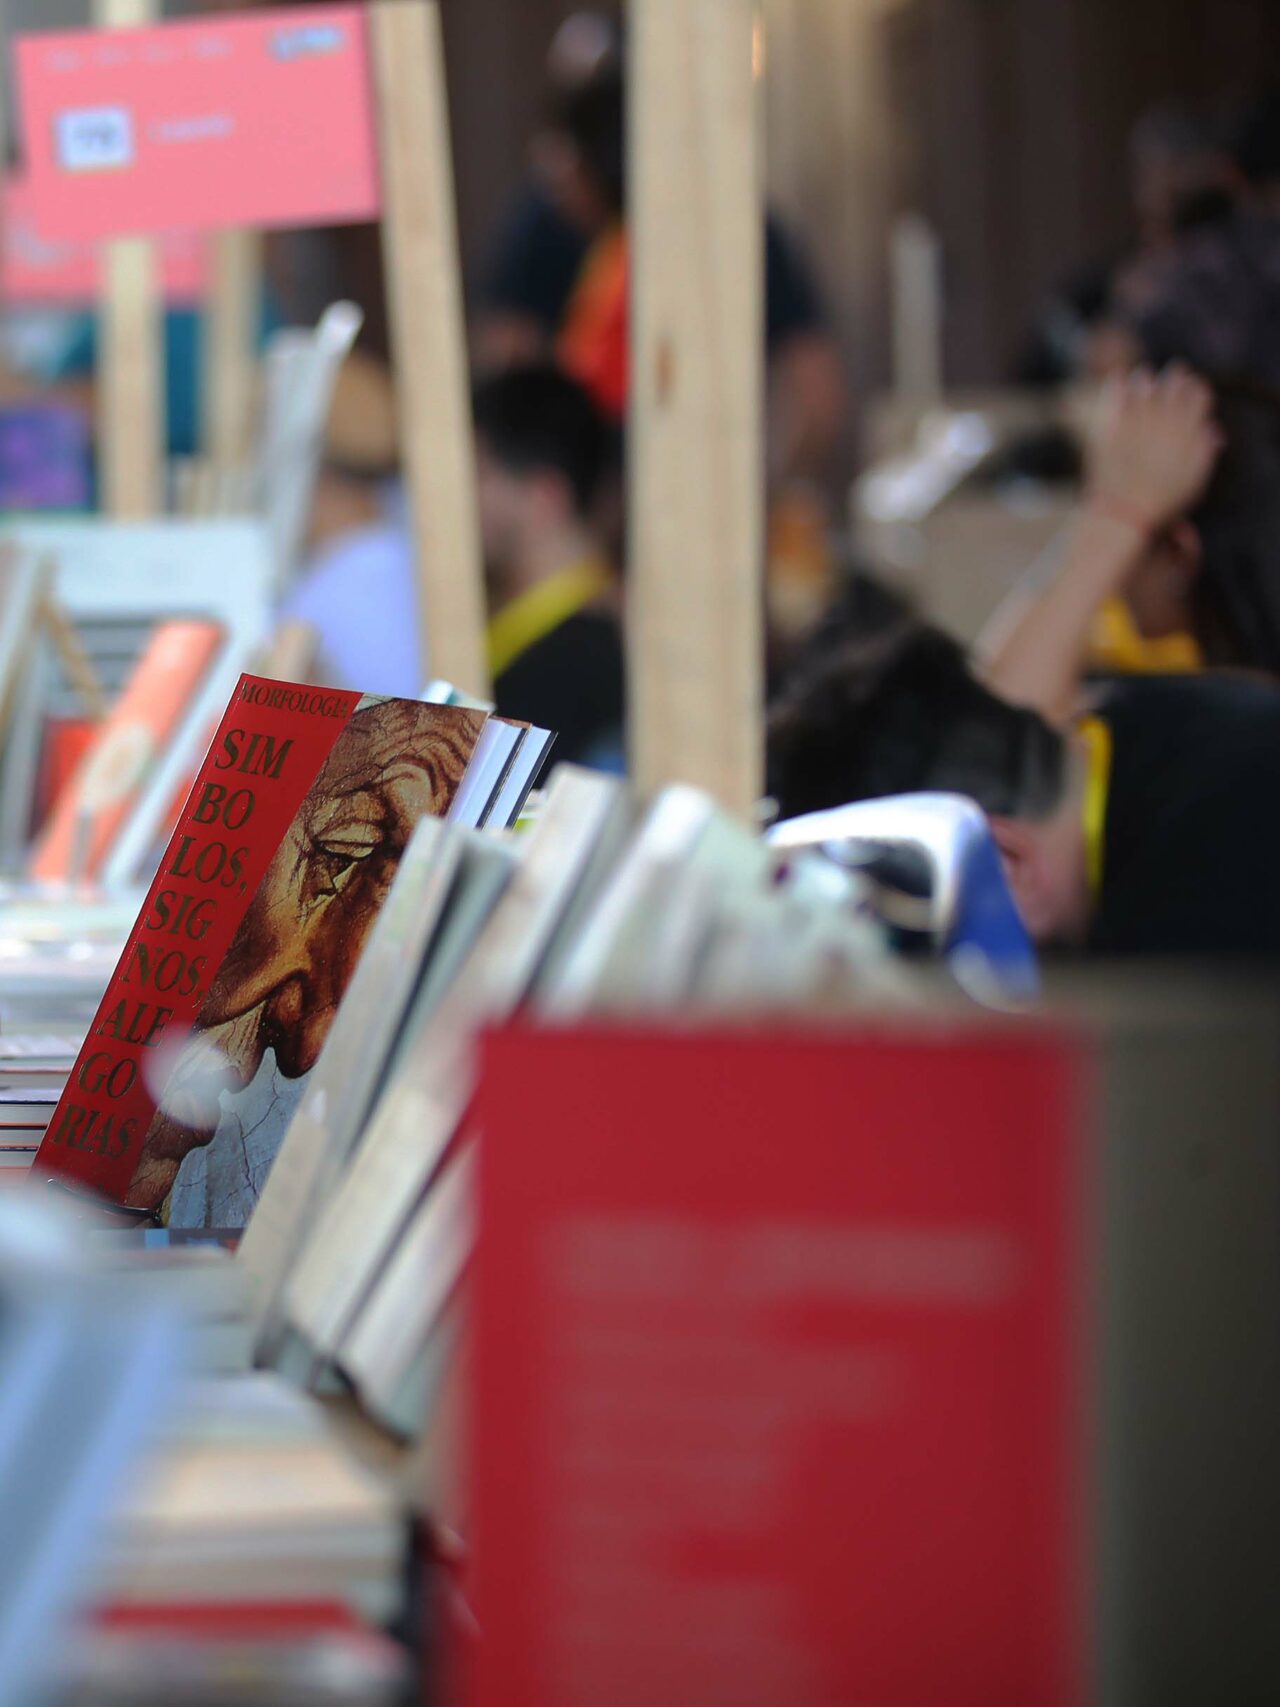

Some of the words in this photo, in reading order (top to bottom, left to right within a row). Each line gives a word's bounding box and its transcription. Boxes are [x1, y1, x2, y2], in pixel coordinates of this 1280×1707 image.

[214, 728, 295, 779] SIM
[192, 782, 253, 830] BO
[170, 834, 248, 895] LOS,
[145, 891, 216, 942] SIG
[123, 943, 207, 1002] NOS,
[95, 998, 174, 1048] ALE
[78, 1051, 138, 1099] GO
[51, 1103, 138, 1160] RIAS
